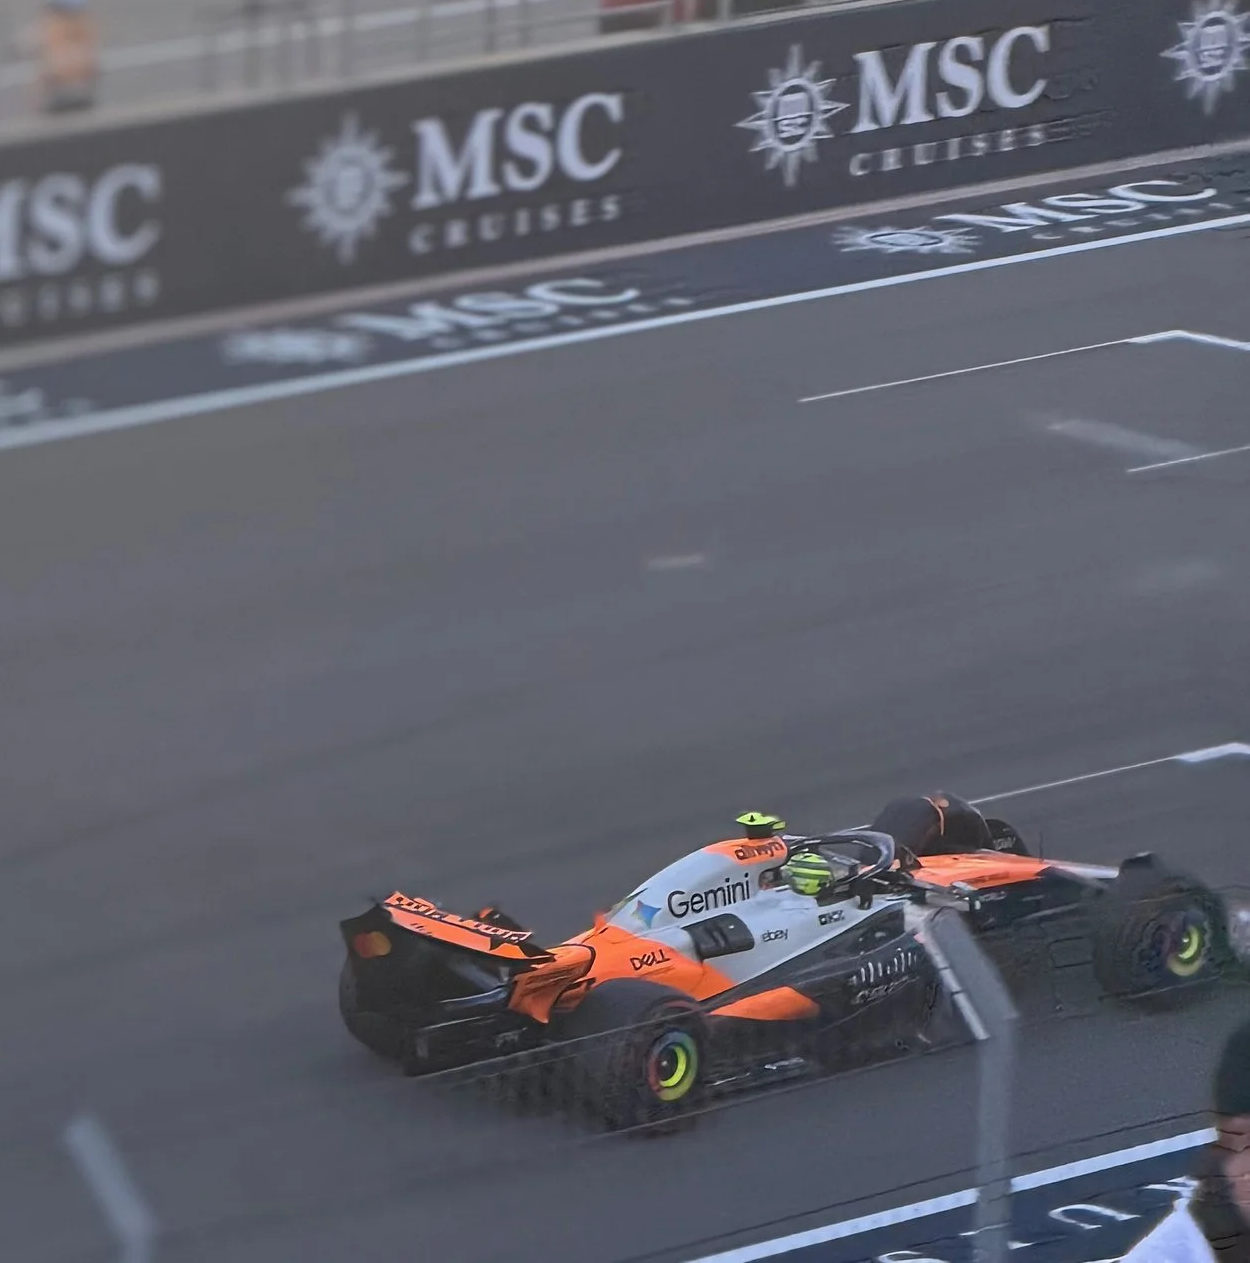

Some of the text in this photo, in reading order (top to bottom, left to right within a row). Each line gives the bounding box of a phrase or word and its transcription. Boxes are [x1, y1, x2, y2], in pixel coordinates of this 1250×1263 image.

[851, 26, 1050, 133] MSC
[411, 91, 623, 210] MSC
[849, 124, 1047, 177] CRUISES
[408, 194, 621, 254] CRUISES
[933, 180, 1217, 233] MSC
[667, 872, 750, 919] Gemini
